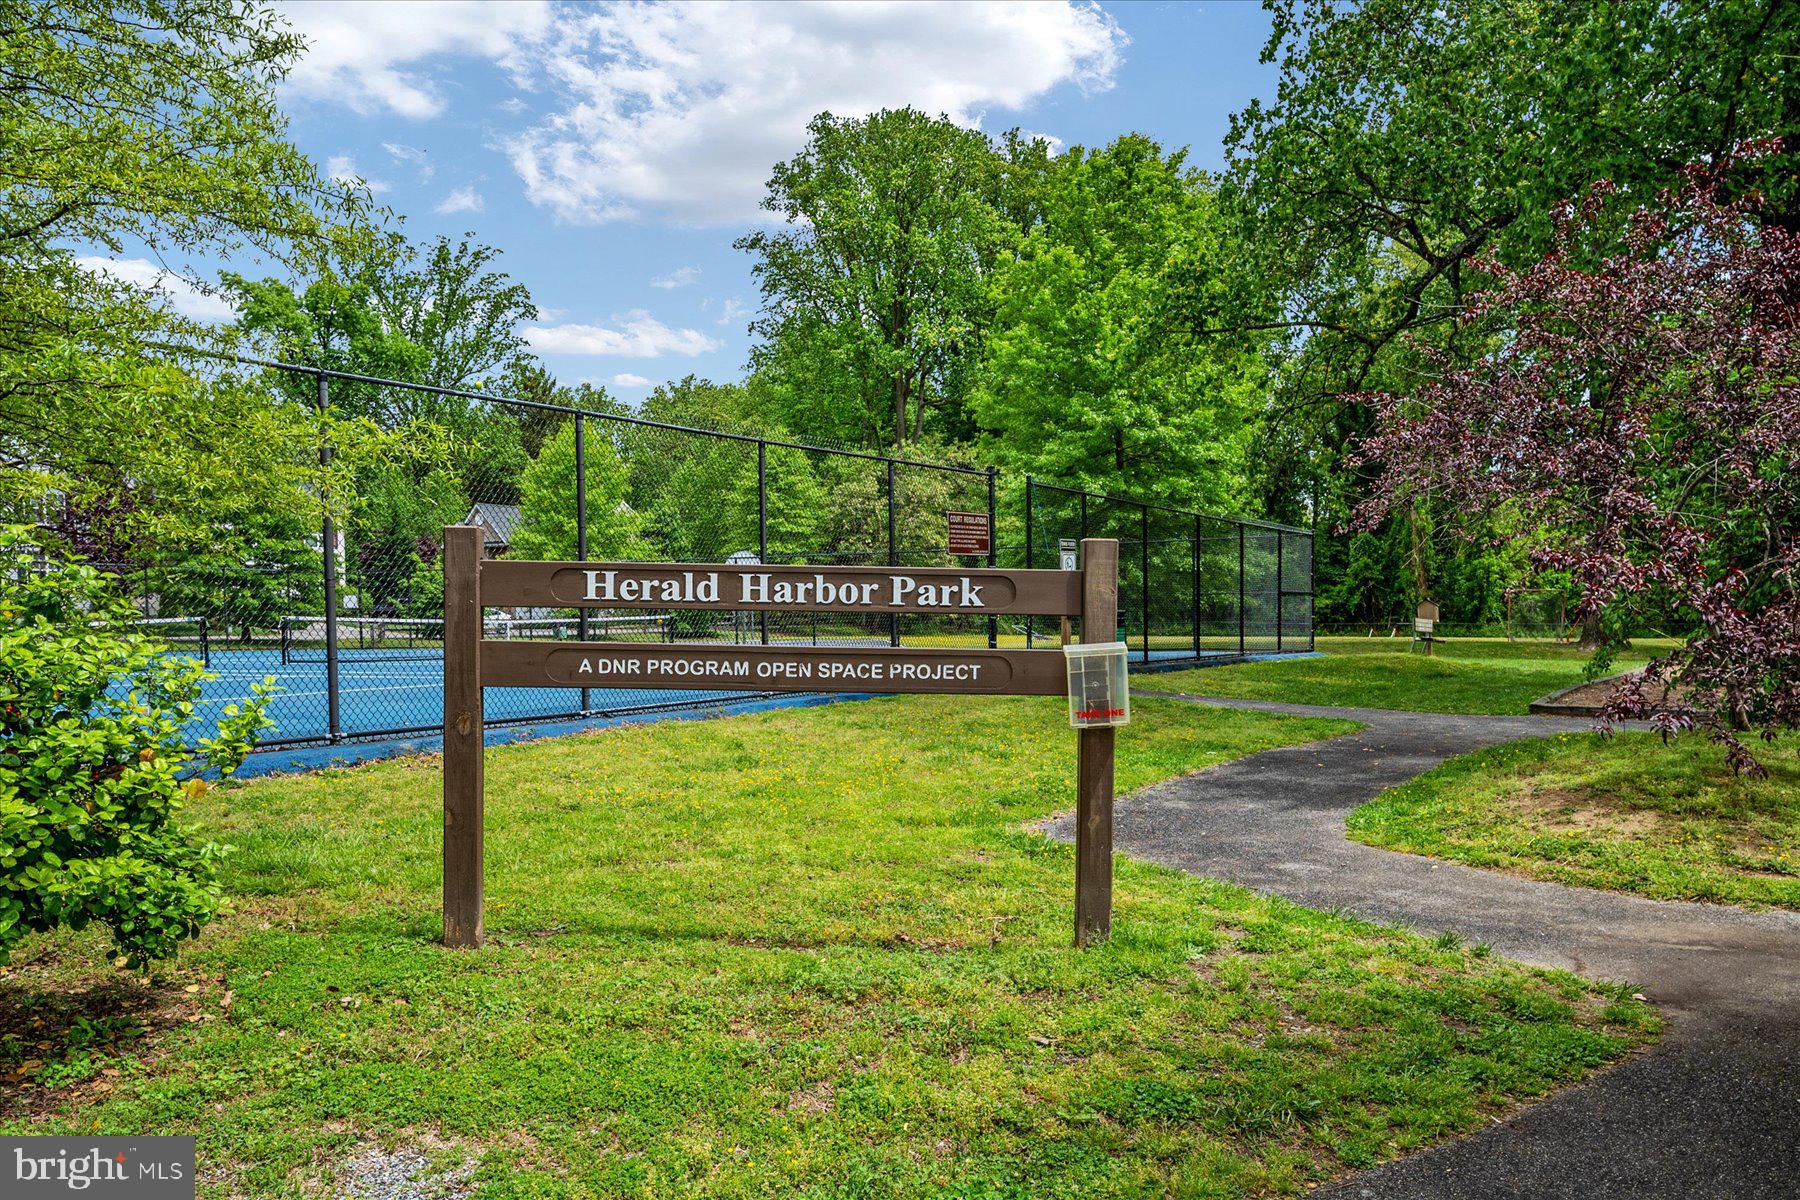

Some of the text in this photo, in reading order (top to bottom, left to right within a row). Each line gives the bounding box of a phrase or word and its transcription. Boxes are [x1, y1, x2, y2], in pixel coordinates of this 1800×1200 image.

[583, 571, 985, 608] Herald Harbor Park
[578, 658, 982, 680] A DNR PROGRAM OPEN SPACE PROJECT
[1075, 708, 1125, 720] TAKE ONE
